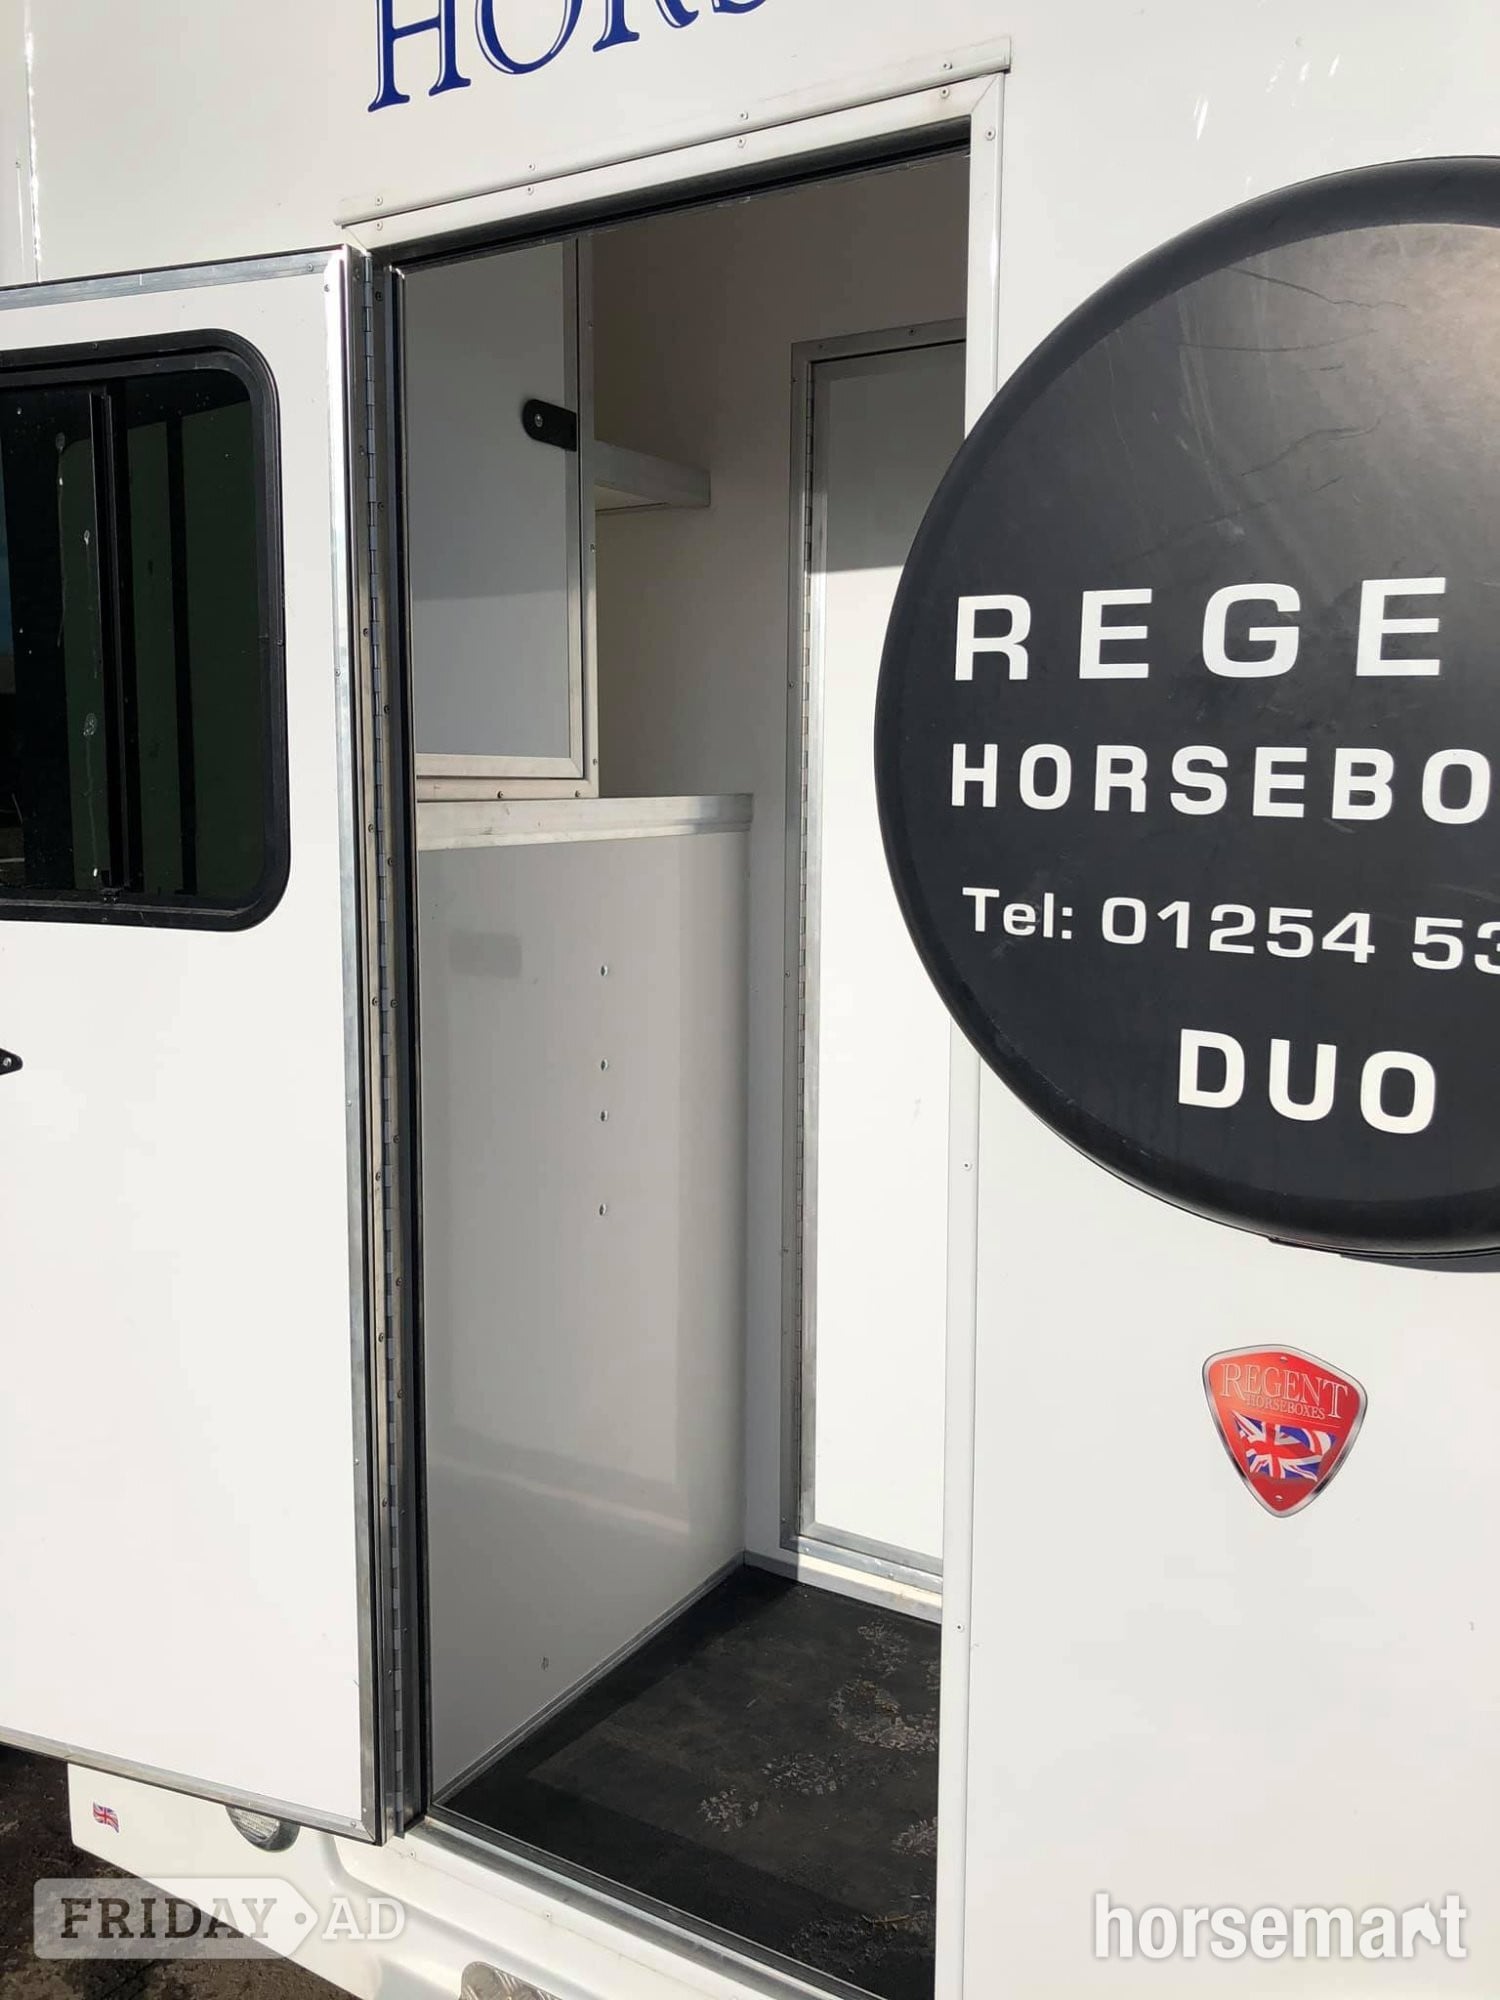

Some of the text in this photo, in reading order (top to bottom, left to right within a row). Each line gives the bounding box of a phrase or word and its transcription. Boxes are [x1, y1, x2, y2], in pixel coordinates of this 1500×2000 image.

[962, 886, 1074, 940] Tel:
[1101, 896, 1376, 964] 01254
[1178, 1028, 1437, 1135] DUO
[1220, 1363, 1348, 1418] REGENT
[1246, 1395, 1326, 1420] HORSEBOXES
